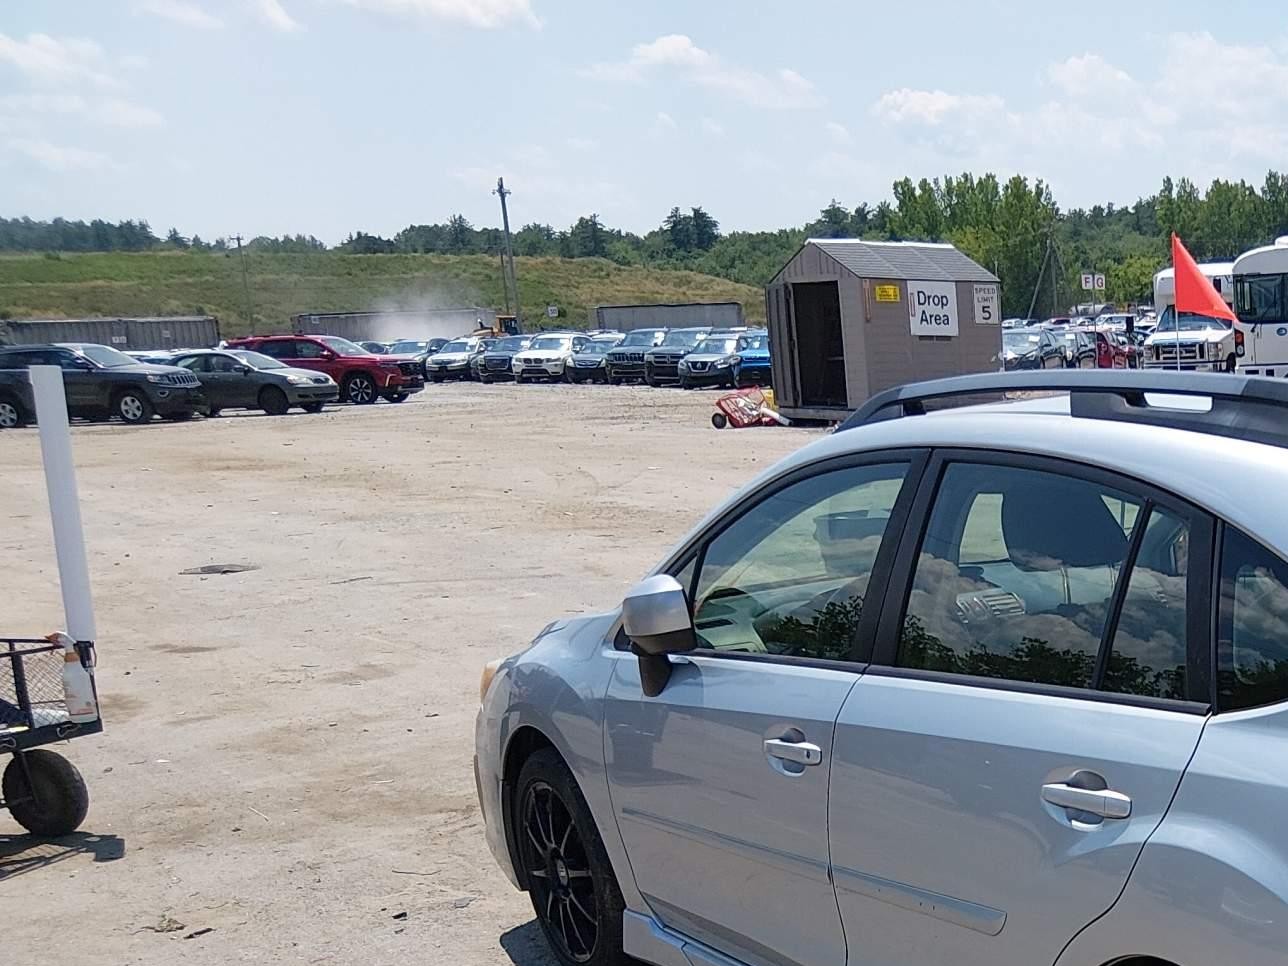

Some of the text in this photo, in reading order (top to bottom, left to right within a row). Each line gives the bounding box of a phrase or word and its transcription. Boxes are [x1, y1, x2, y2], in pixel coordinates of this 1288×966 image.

[1084, 276, 1091, 288] F
[1096, 277, 1104, 288] G
[974, 287, 996, 295] SPEED
[917, 290, 949, 310] Drop
[920, 309, 950, 326] Area
[982, 305, 992, 321] 5
